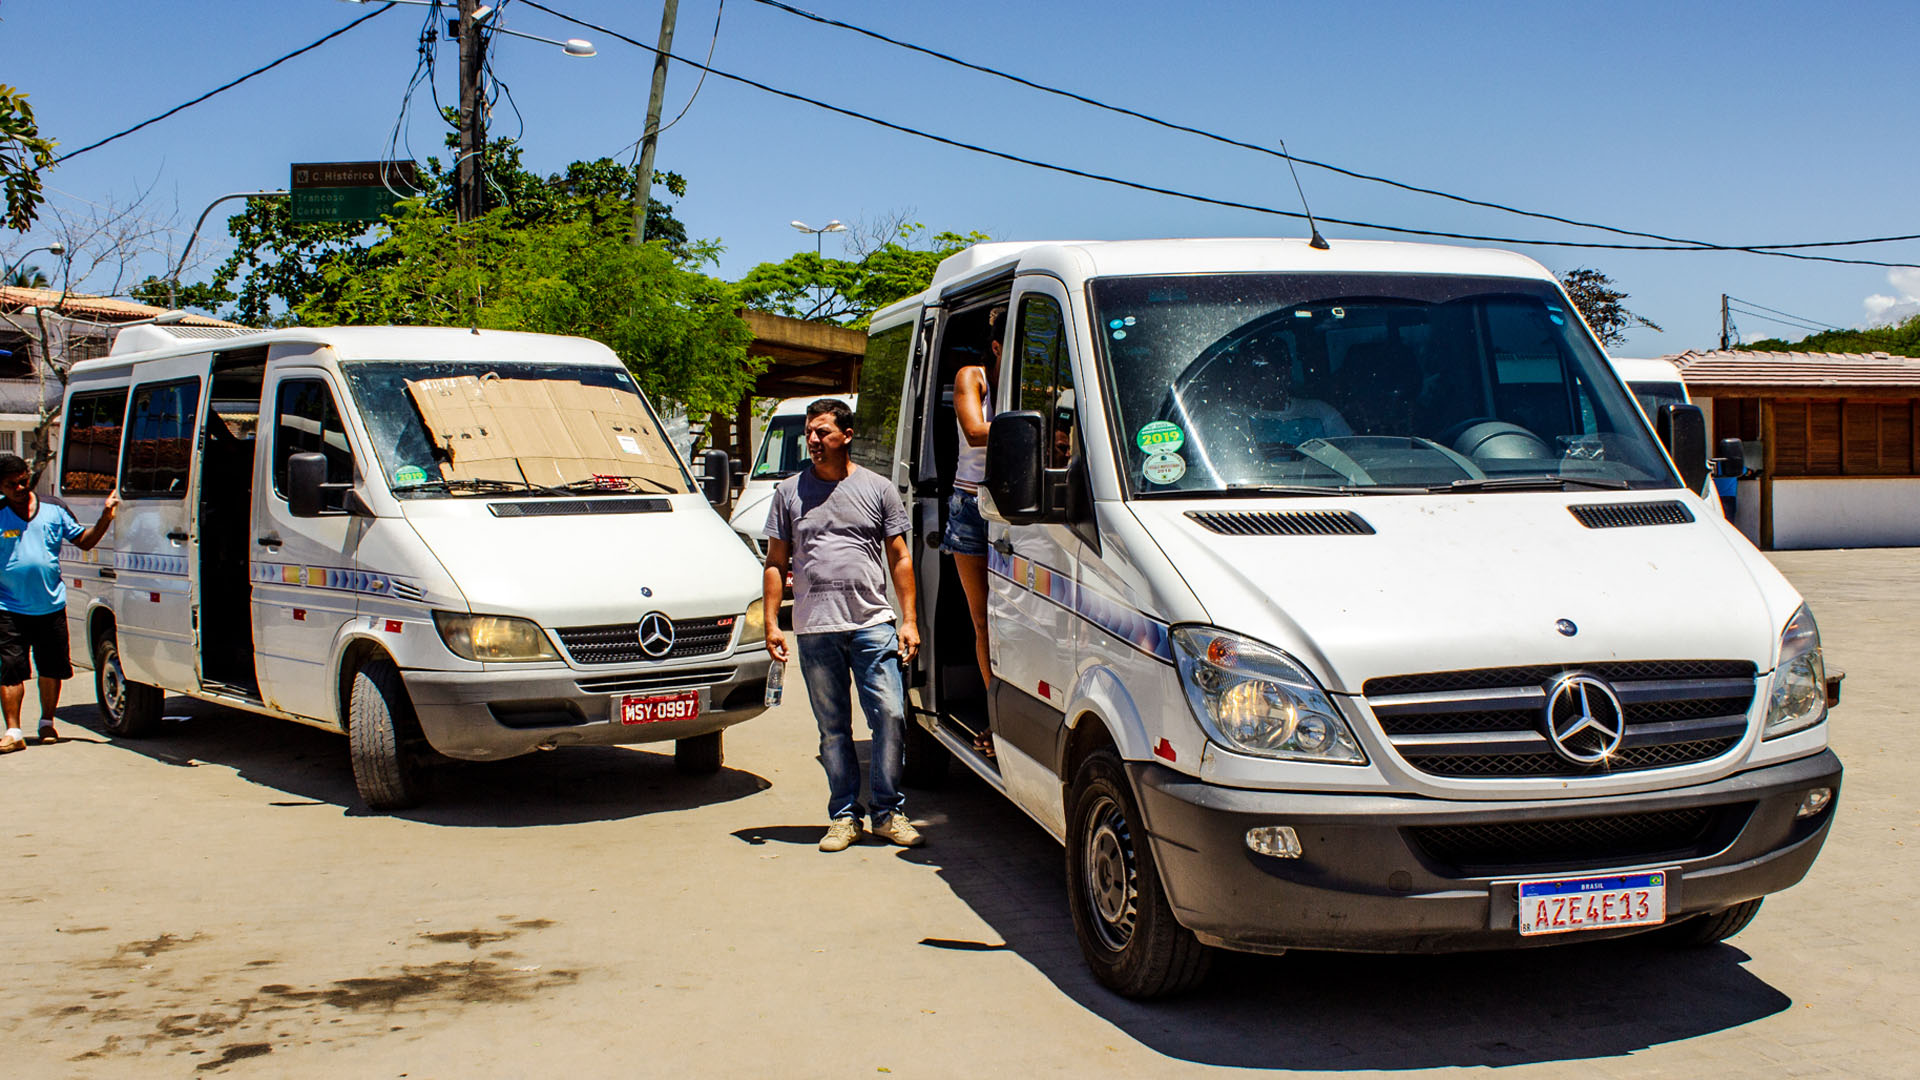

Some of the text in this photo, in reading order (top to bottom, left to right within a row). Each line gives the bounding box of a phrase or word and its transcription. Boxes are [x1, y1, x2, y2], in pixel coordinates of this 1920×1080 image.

[312, 172, 322, 181] C.
[324, 170, 375, 181] Histórico
[296, 193, 345, 203] Trancoso
[376, 191, 389, 201] 37
[1142, 431, 1180, 446] 2019
[1581, 883, 1604, 891] BRASIL
[1535, 891, 1649, 928] AZE4E13
[1522, 923, 1532, 932] BR
